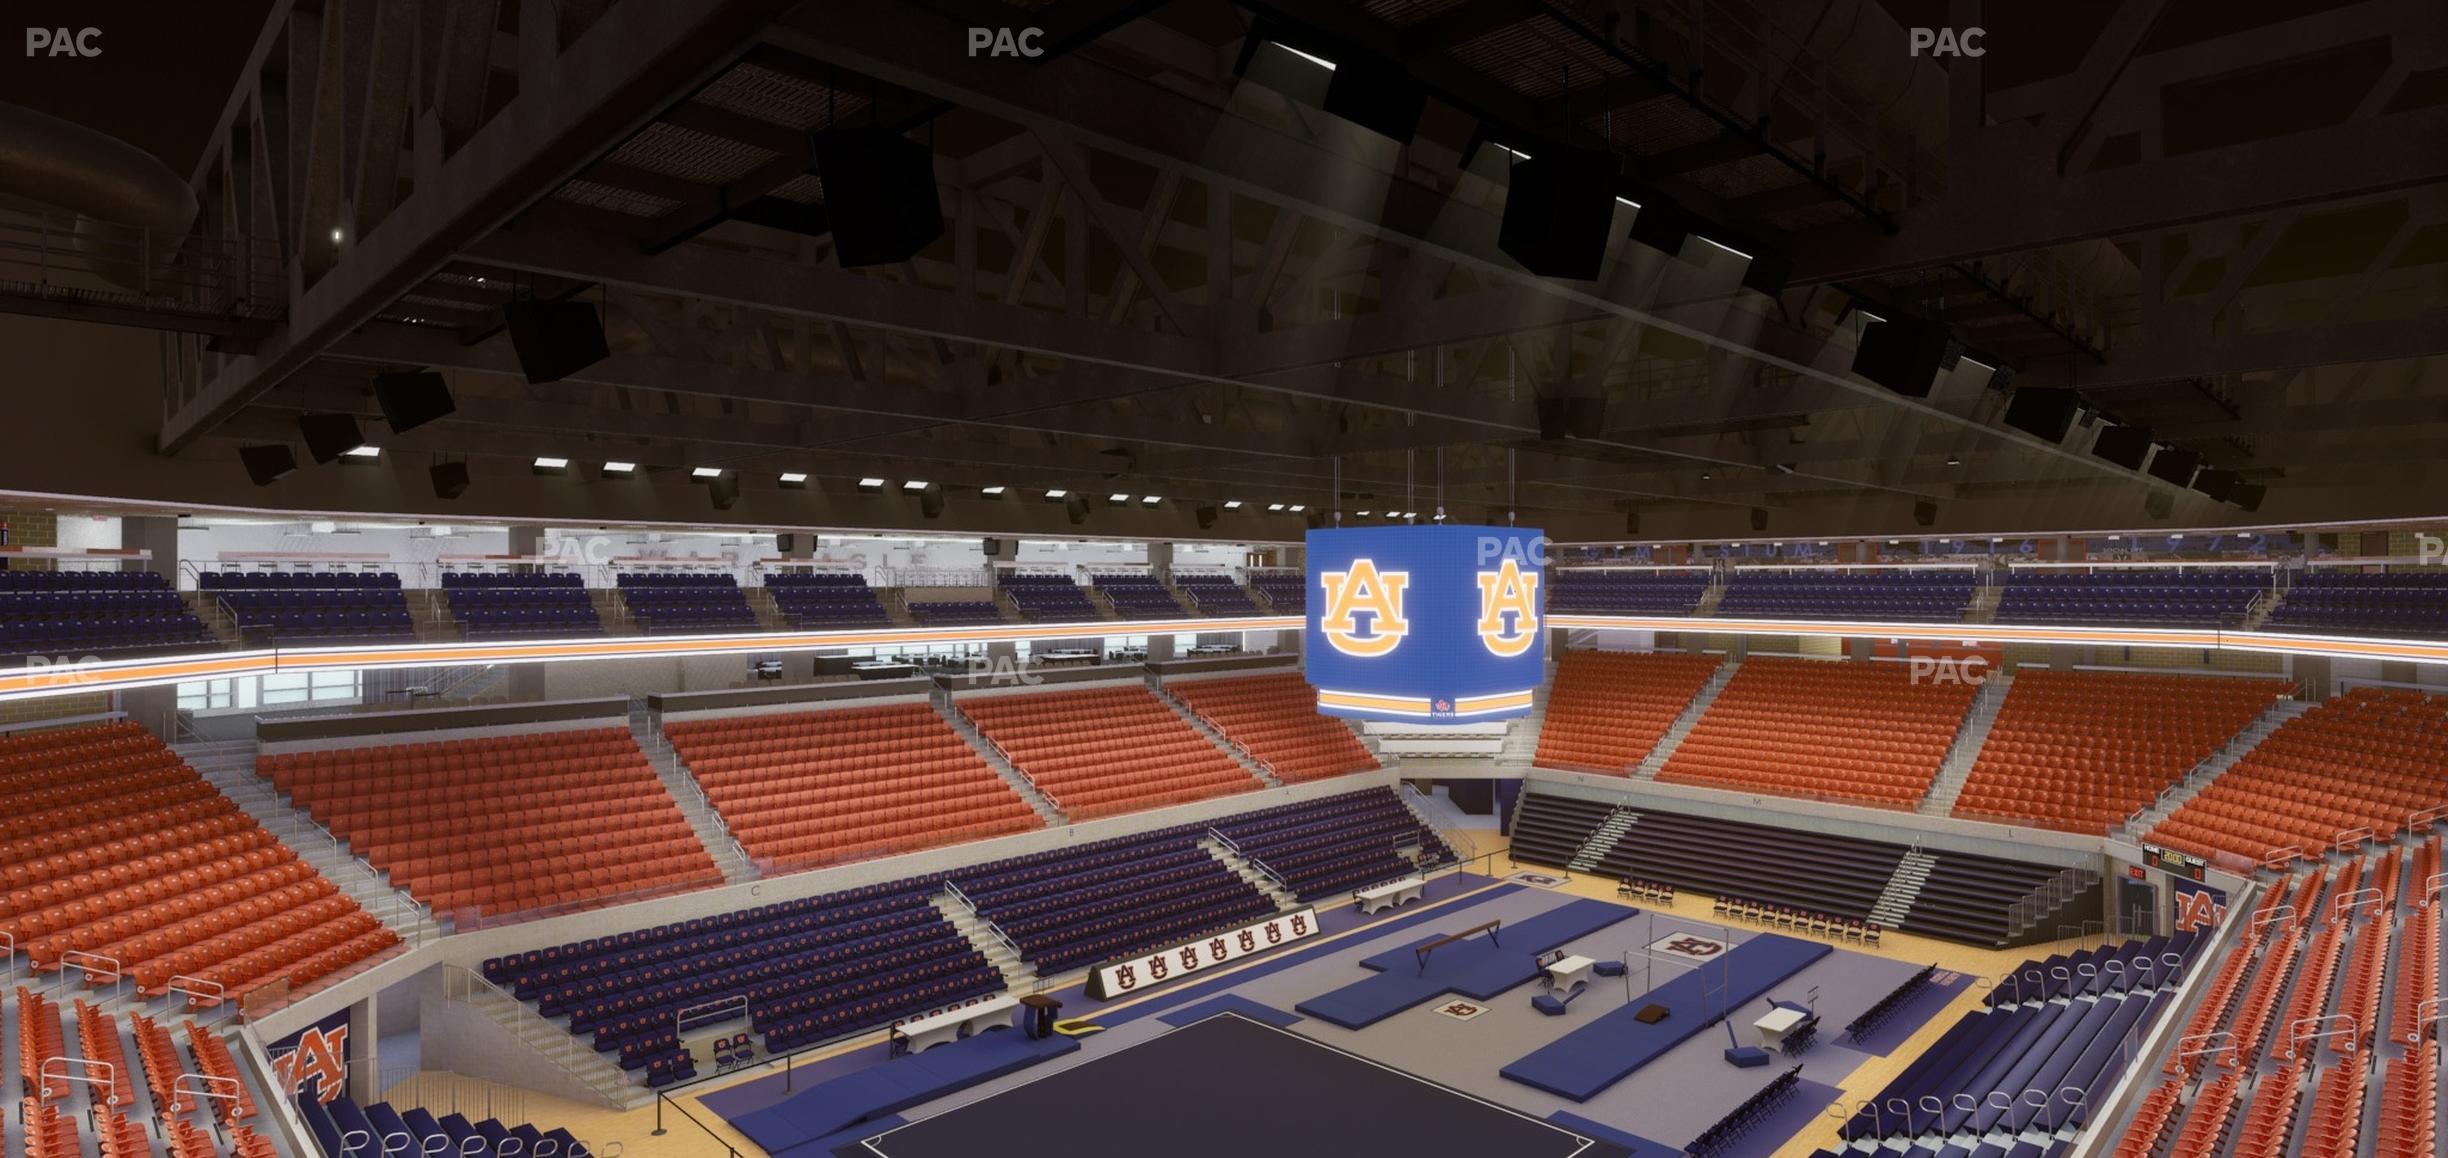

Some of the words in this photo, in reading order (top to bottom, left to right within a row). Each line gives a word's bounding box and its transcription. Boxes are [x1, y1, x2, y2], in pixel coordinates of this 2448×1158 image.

[2144, 843, 2160, 854] HOME
[2185, 855, 2204, 867] GUEST
[2129, 867, 2144, 879] EXIT
[751, 885, 761, 896] C
